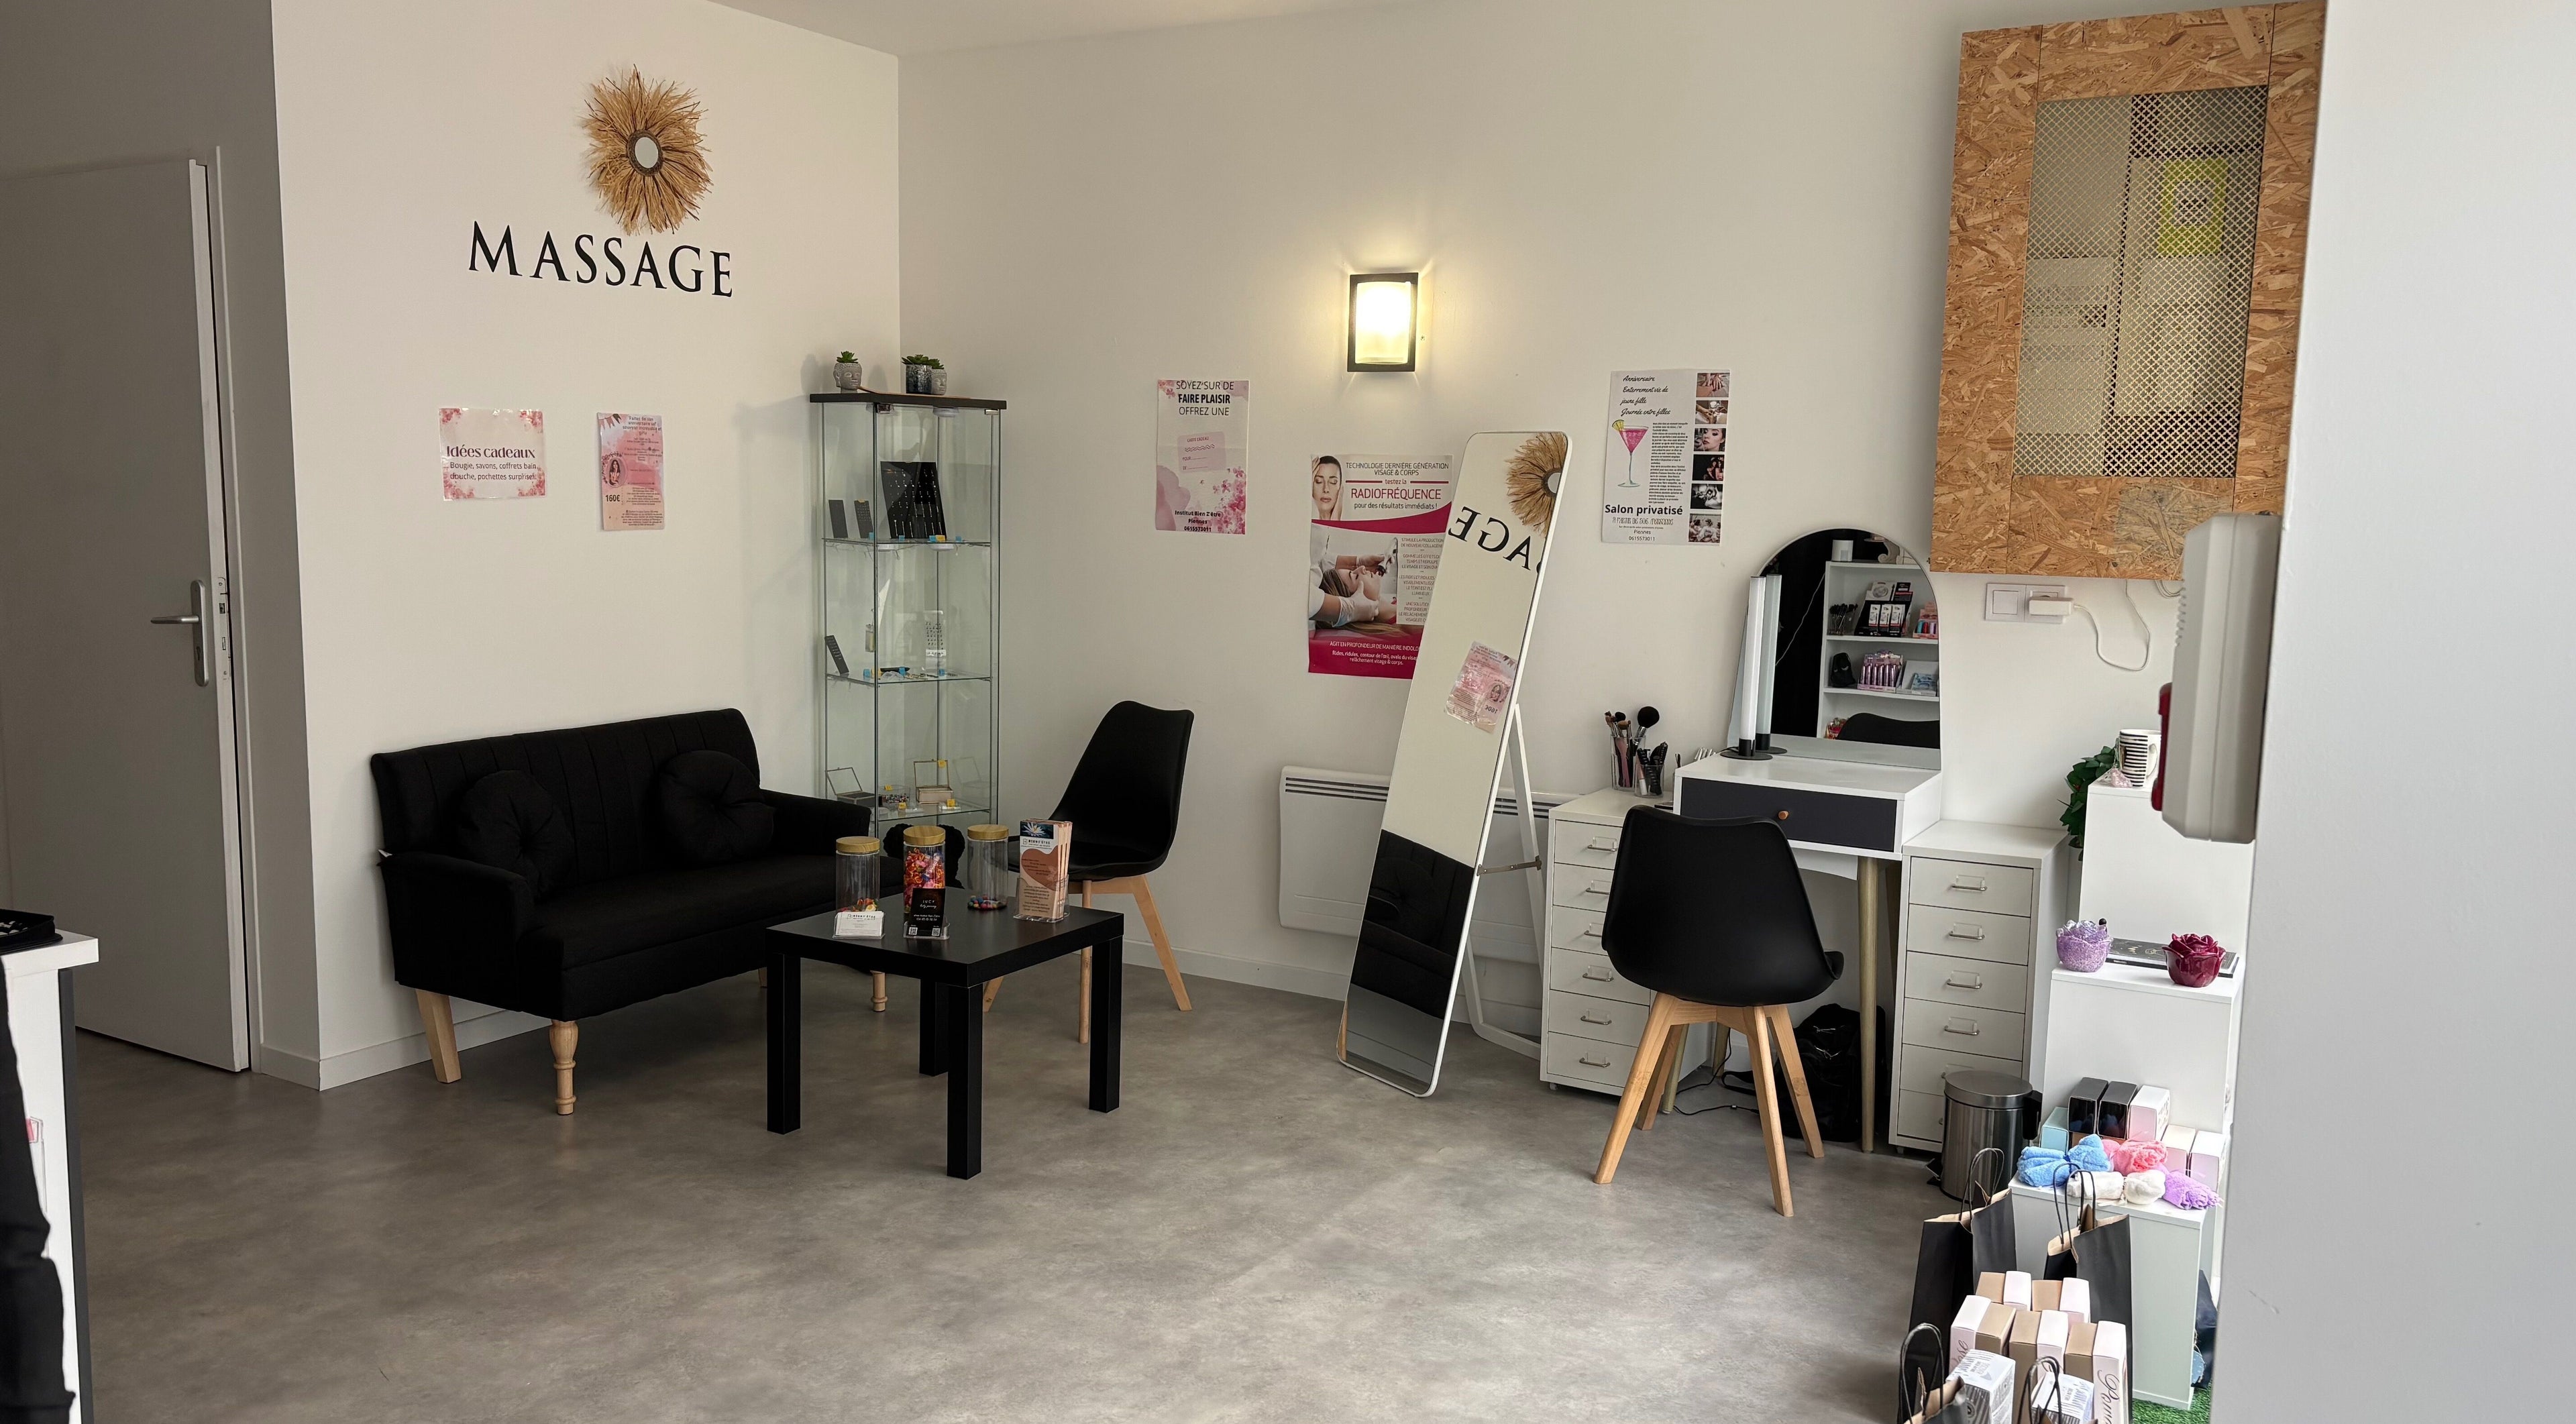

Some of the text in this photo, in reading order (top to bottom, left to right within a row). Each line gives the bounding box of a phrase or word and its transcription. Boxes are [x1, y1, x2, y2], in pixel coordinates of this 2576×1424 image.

[468, 221, 733, 297] MASSAGE
[1176, 380, 1202, 390] SOYEZ
[1222, 381, 1234, 390] DE
[1178, 394, 1230, 404] FAIRE PLAISIR
[1635, 397, 1647, 405] fille
[1179, 406, 1230, 416] OFFREZ UNE
[1621, 408, 1643, 417] Journée
[1656, 408, 1671, 417] filles
[447, 444, 535, 458] Idées cadeaux
[450, 461, 474, 470] Bougie,
[1413, 461, 1449, 470] GÉNÉRATION
[450, 472, 476, 480] douche,
[605, 494, 621, 502] 160€
[1351, 487, 1442, 501] RADIOFRÉQUENCE
[1605, 504, 1683, 516] Salon privatisé
